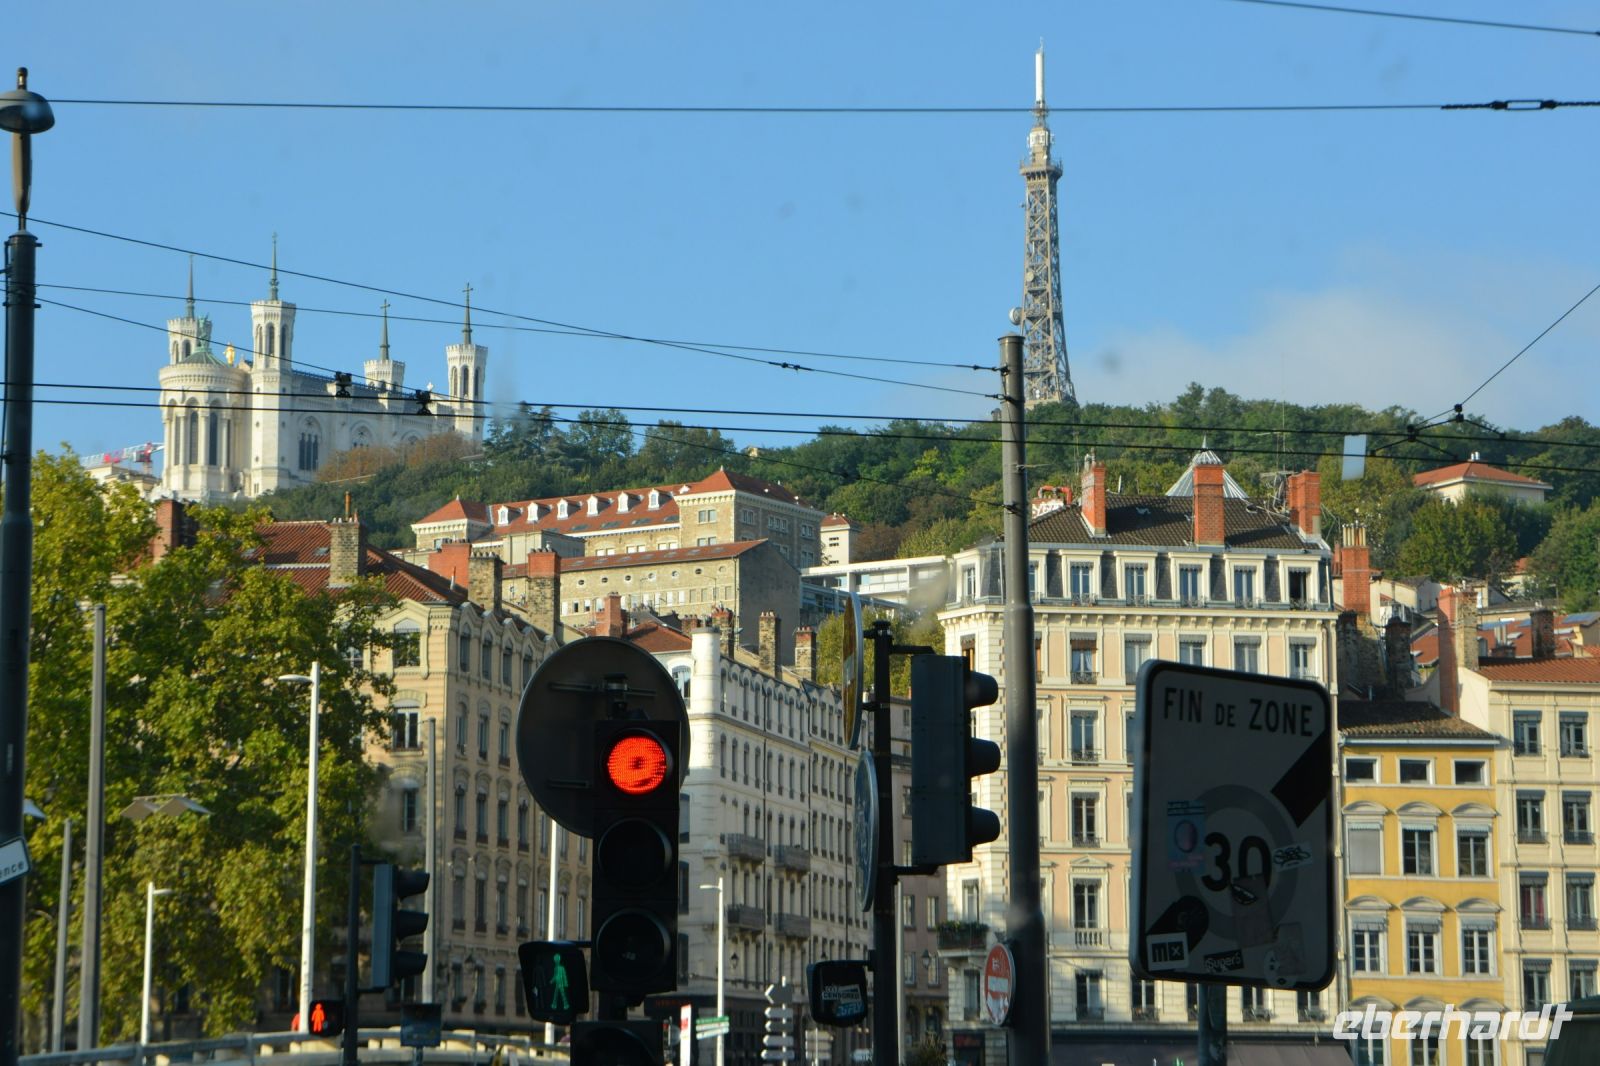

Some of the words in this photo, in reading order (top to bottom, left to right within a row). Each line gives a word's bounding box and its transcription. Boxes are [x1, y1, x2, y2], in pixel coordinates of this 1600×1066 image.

[1163, 687, 1203, 723] FIN
[1215, 703, 1236, 727] DE
[1248, 698, 1313, 737] ZONE
[1202, 832, 1273, 892] 30
